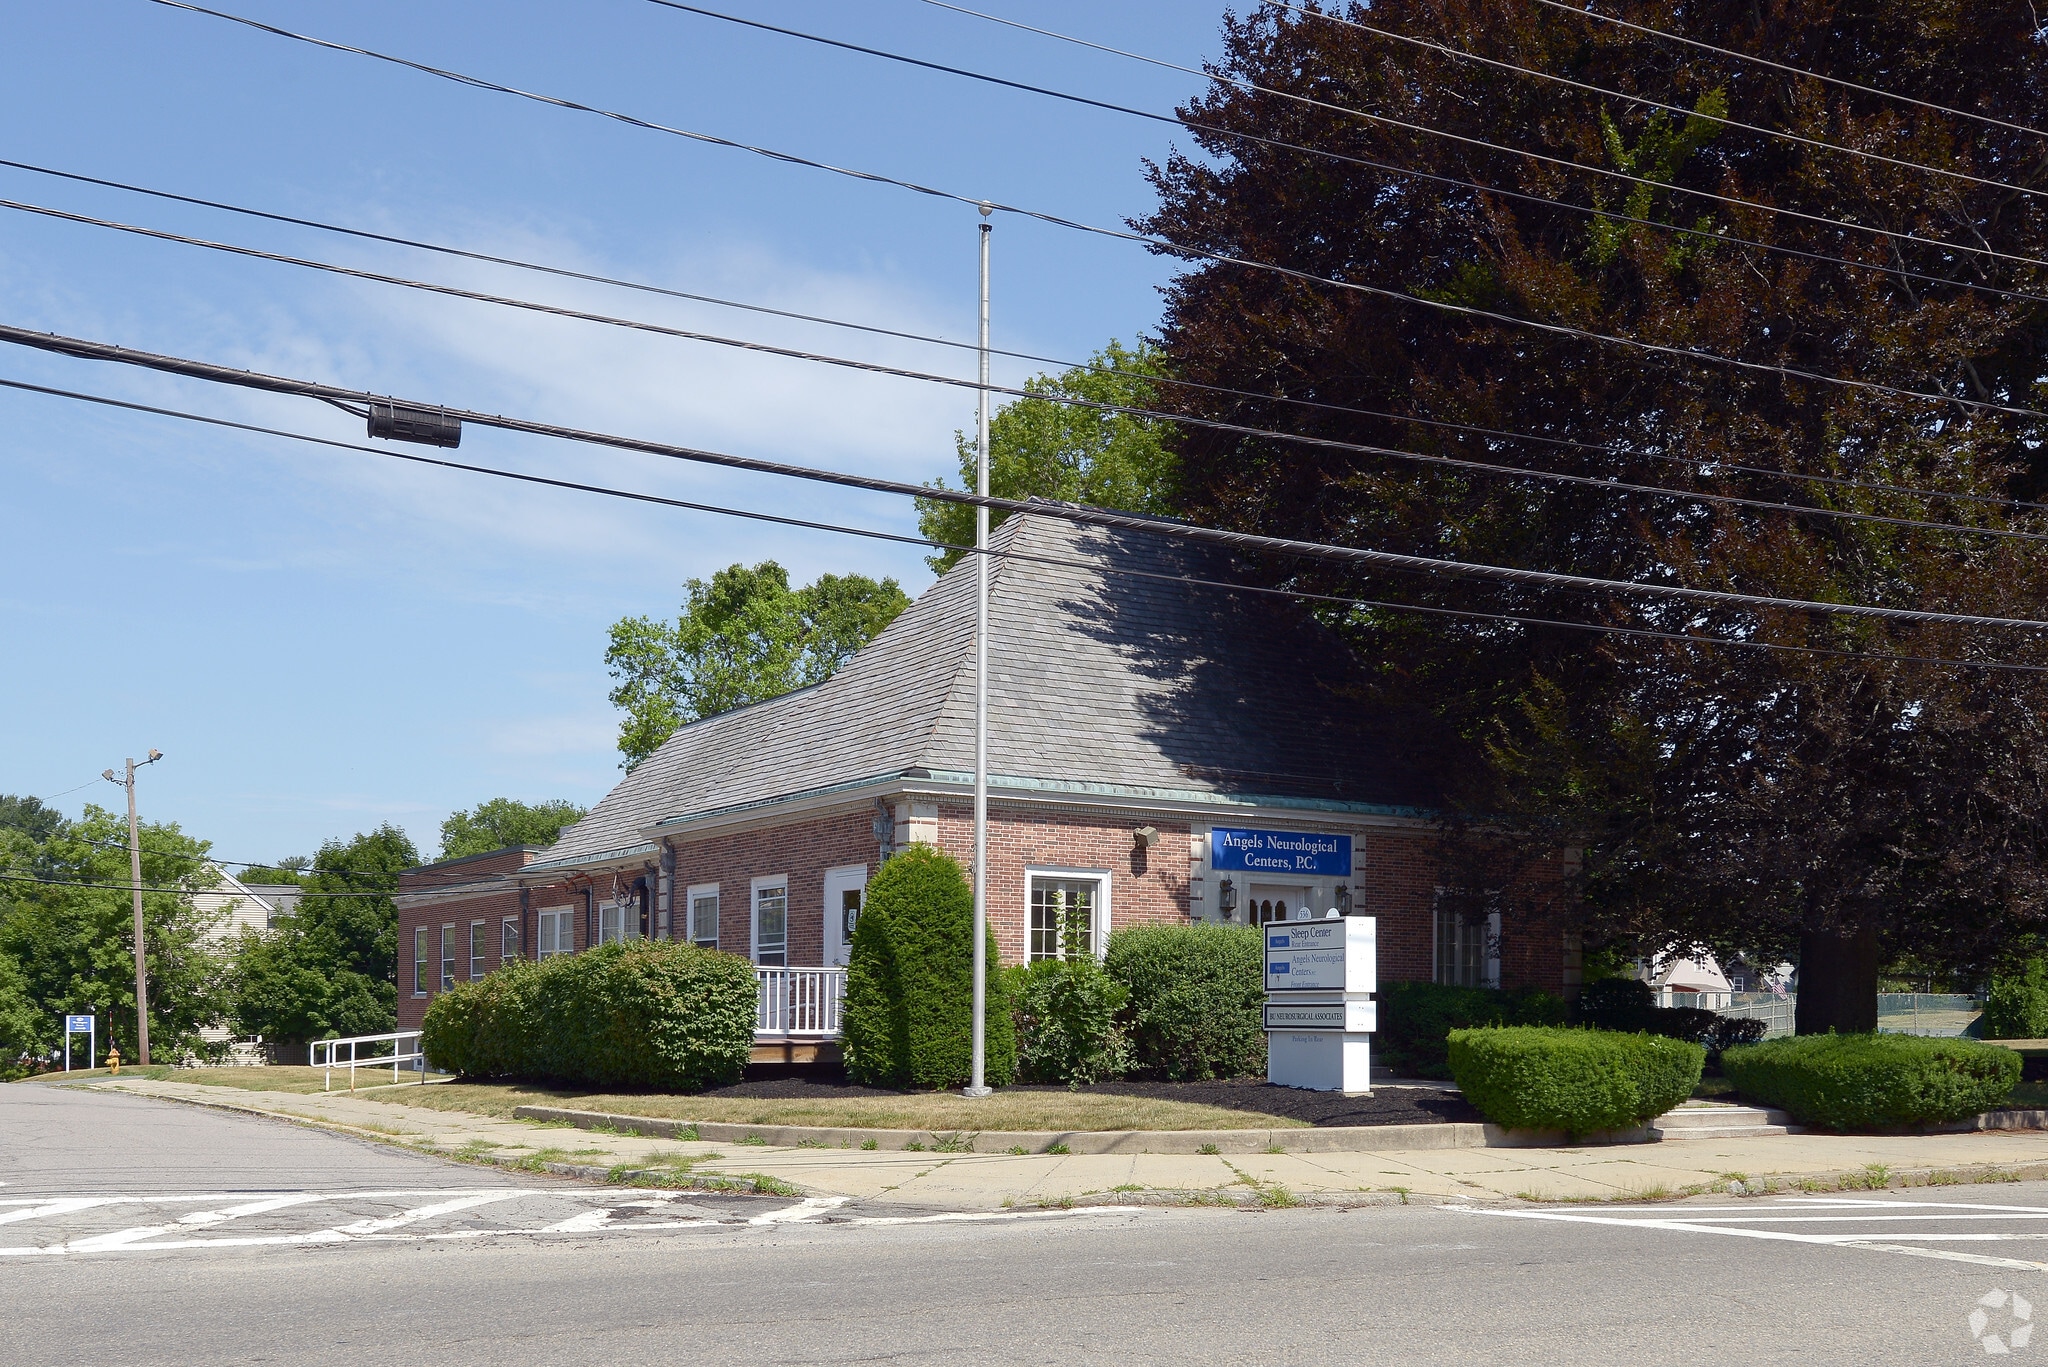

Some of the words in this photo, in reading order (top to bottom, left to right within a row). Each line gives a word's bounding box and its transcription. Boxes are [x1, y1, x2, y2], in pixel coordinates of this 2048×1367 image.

[1223, 832, 1263, 850] Angels
[1267, 835, 1337, 855] Neurological
[1244, 852, 1292, 871] Centers,
[1295, 855, 1317, 870] P.C.
[1291, 928, 1309, 940] Sleep
[1310, 927, 1332, 938] Center
[1292, 954, 1311, 966] Angels
[1311, 953, 1345, 965] Neurological
[1291, 967, 1312, 977] Centers
[1276, 1012, 1314, 1020] NEUROSURGICAL
[1314, 1012, 1343, 1020] ASSOCIATES
